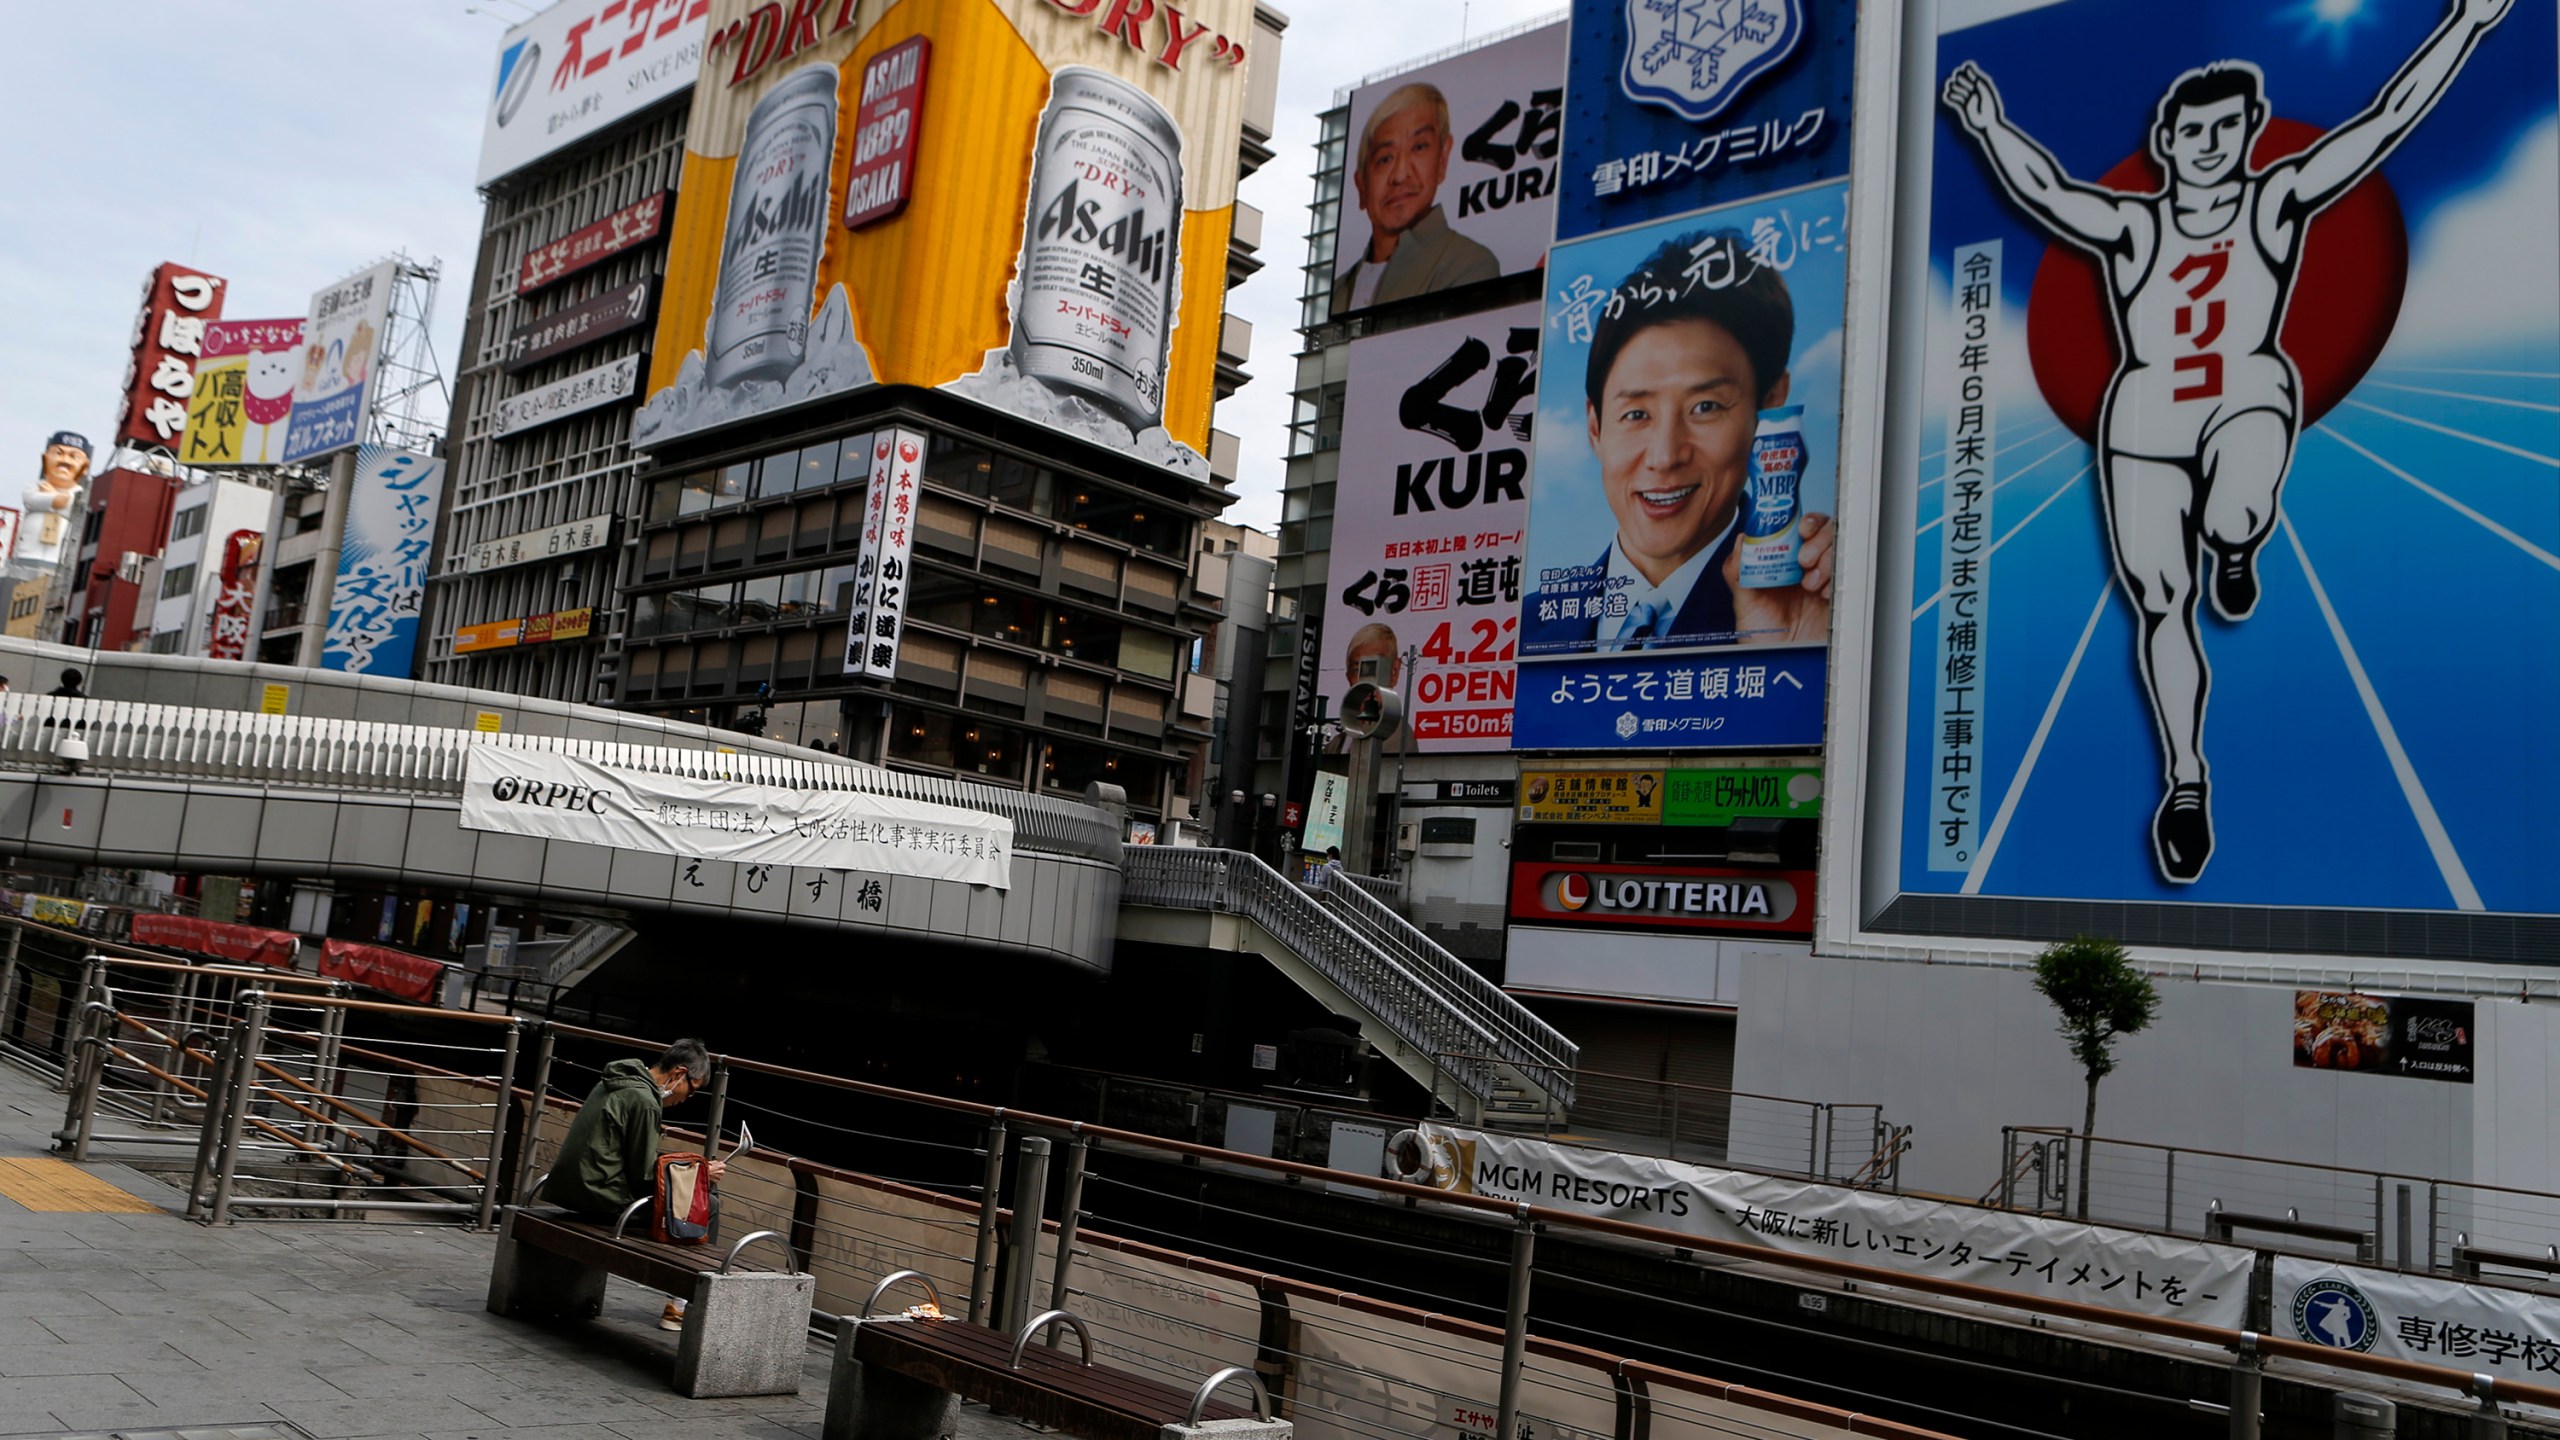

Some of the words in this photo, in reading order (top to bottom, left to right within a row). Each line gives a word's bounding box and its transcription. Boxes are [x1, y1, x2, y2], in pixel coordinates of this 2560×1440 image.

[862, 45, 920, 107] ASAHI
[854, 108, 911, 167] 1889
[1591, 107, 1826, 197] 雪印メグミルク
[1071, 139, 1087, 151] THE
[1090, 144, 1120, 162] JAPAN
[1122, 157, 1153, 184] BRAND
[1096, 156, 1128, 177] SUPER
[845, 160, 902, 218] OSAKA
[729, 168, 820, 266] Asahi
[1038, 177, 1165, 285] Asahi
[753, 249, 779, 281] 生
[1079, 262, 1117, 301] 生
[1056, 299, 1131, 339] スーパードライ
[1074, 322, 1110, 344] 生ビール
[2167, 238, 2236, 404] グリコ
[1071, 355, 1104, 381] 350ml
[187, 370, 224, 459] バイト
[207, 369, 247, 458] 高収入
[1758, 474, 1796, 498] MBP
[889, 468, 913, 549] 本場の味
[1758, 514, 1789, 527] ドリンク
[548, 524, 594, 555] 白木屋
[1384, 534, 1467, 559] 西日本初上陸
[1539, 565, 1605, 582] 雪印メグミルク
[1539, 575, 1636, 596] 健康推進アンバサダー
[847, 553, 875, 666] かに道楽
[871, 555, 903, 670] かに道楽
[1537, 592, 1628, 622] 松岡修造
[1417, 669, 1515, 705] OPEN
[1550, 664, 1804, 705] ようこそ道頓堀へ
[1642, 716, 1725, 733] 雪印メグミルク
[1464, 783, 1500, 797] Toilets
[1554, 777, 1628, 792] 店舗情報館
[1714, 775, 1780, 808] ピタットハウス
[632, 800, 778, 836] 一般社団法人
[788, 821, 1001, 863] 大阪活性化事業実行委員会
[1285, 807, 1299, 824] 本
[1534, 811, 1563, 821] 株式会社
[682, 862, 884, 914] えびす橋
[1598, 877, 1770, 915] LOTTERIA
[1477, 1160, 1543, 1196] MGM
[1550, 1172, 1690, 1218] RESORTS
[2318, 1282, 2349, 1294] CLARK
[2396, 1313, 2560, 1373] 専修学校
